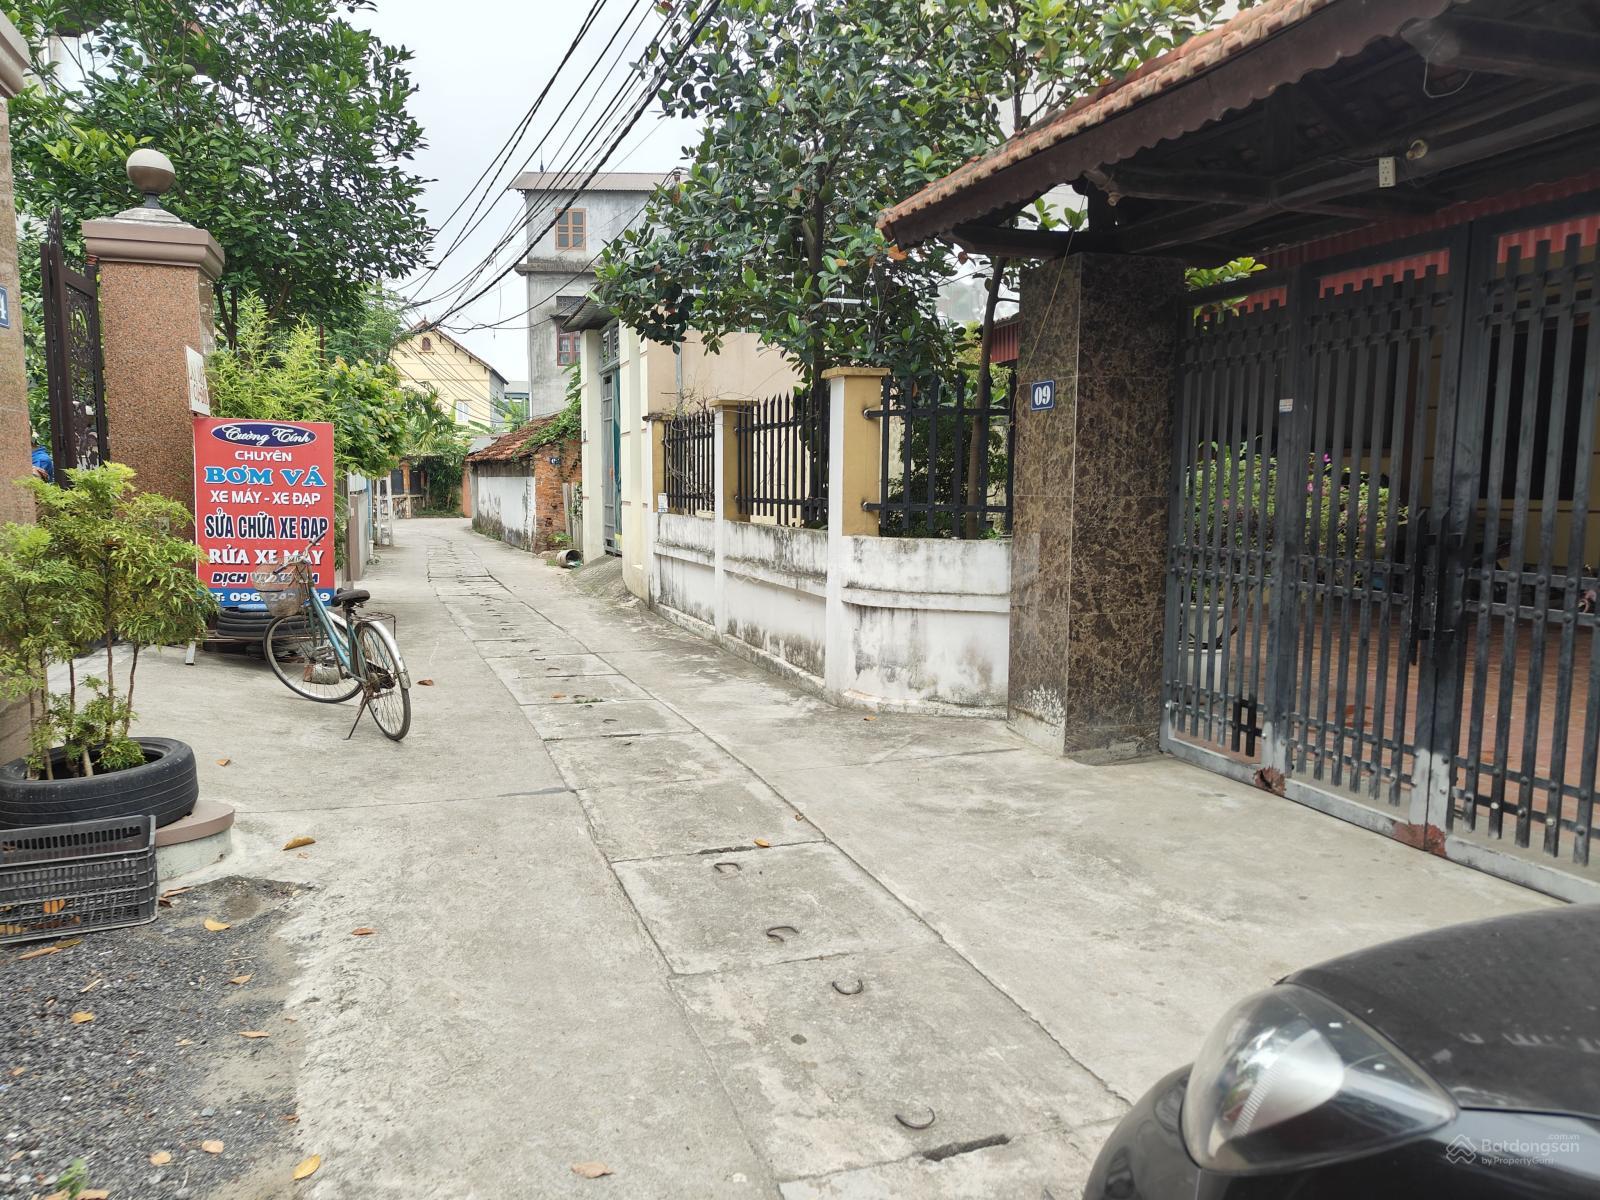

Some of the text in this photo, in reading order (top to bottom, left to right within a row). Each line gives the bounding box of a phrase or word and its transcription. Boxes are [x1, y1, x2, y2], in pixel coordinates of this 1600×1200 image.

[1034, 385, 1051, 406] 09
[234, 449, 292, 462] CHUYÊN
[204, 463, 326, 487] BƠM VÁ
[210, 490, 228, 503] XE
[231, 488, 262, 504] MÁY
[271, 491, 290, 504] XE
[292, 492, 321, 508] ĐẠP
[204, 507, 235, 539] SỬA
[238, 512, 276, 539] CHỮA
[278, 516, 298, 539] XE
[208, 543, 250, 565] RỬA
[254, 549, 278, 565] XE
[211, 571, 248, 587] DỊCH
